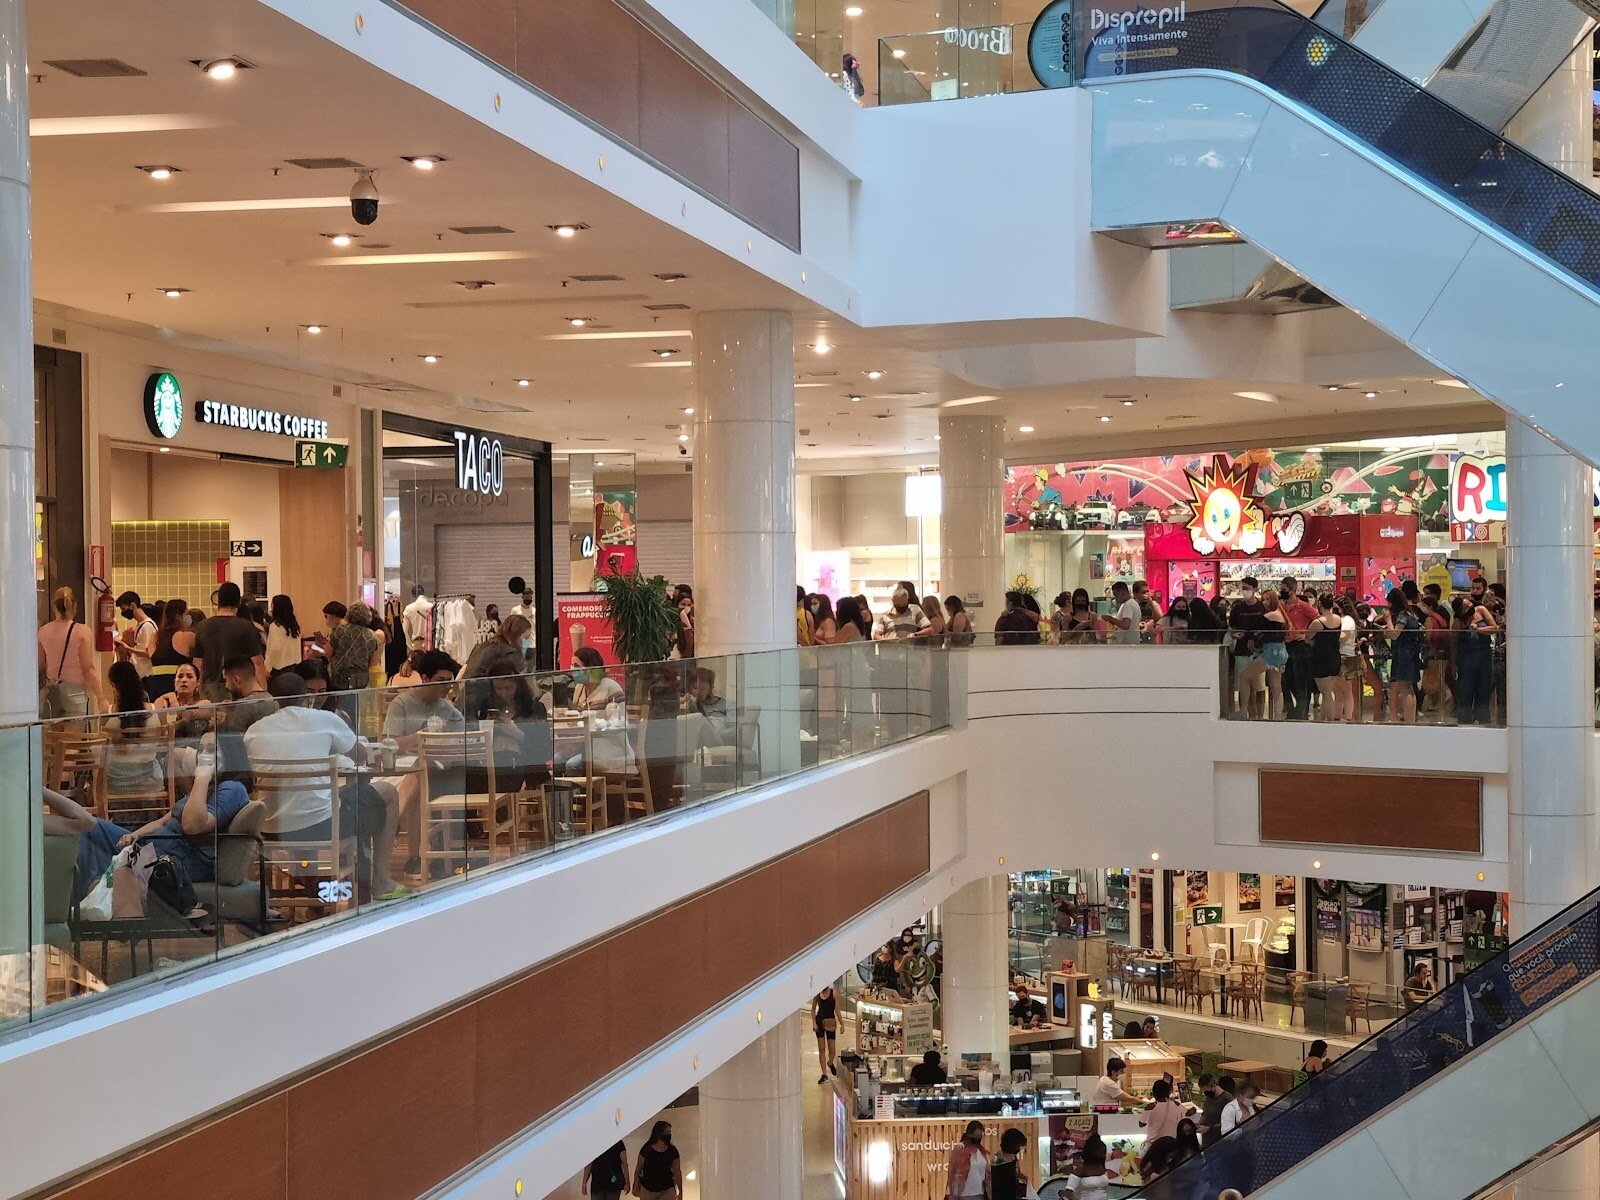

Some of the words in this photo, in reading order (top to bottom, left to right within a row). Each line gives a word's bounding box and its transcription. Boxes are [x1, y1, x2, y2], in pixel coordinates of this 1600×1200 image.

[1090, 0, 1186, 32] Dispropil
[1091, 36, 1114, 46] Viva
[1116, 29, 1188, 44] intensamente
[203, 399, 282, 434] STARBUCKS
[283, 414, 328, 439] COFFEE
[454, 431, 503, 496] TACO
[1502, 963, 1511, 973] O
[1508, 968, 1525, 981] que
[1525, 953, 1546, 970] você
[1545, 933, 1578, 958] procura
